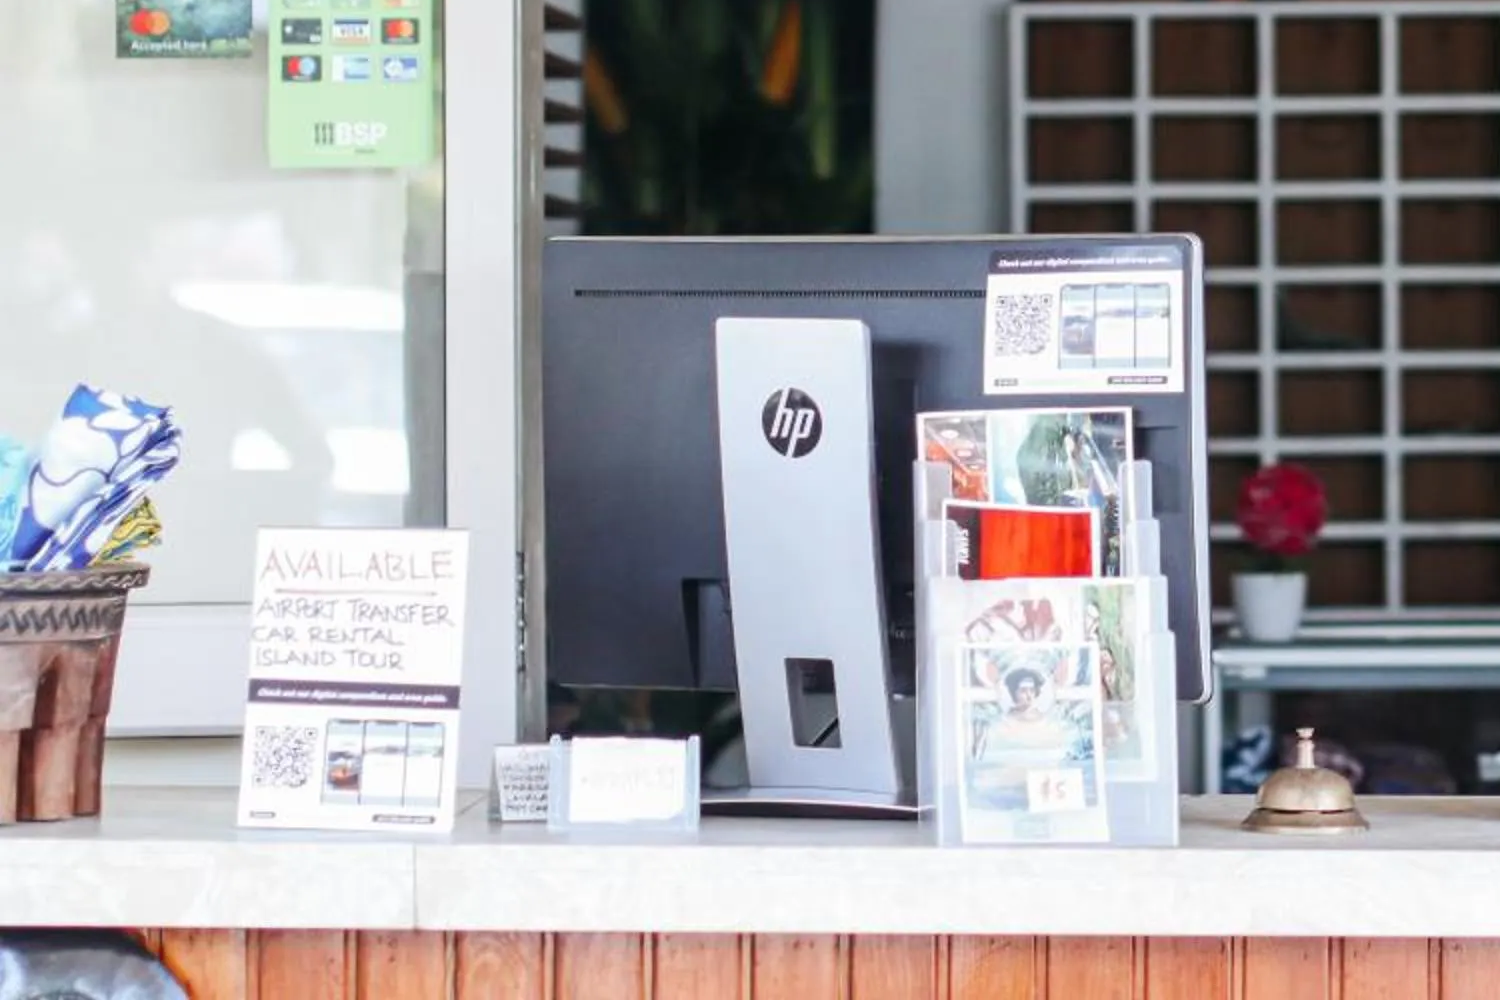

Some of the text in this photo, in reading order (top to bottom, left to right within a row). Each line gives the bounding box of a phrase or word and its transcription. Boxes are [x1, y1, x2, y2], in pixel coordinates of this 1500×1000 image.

[767, 387, 816, 459] hp
[259, 548, 455, 581] AVAILABLE
[256, 597, 456, 628] AIRPORT TRANSFER
[251, 626, 405, 647] CAR RENTAL
[255, 647, 405, 670] ISLAND TOUR
